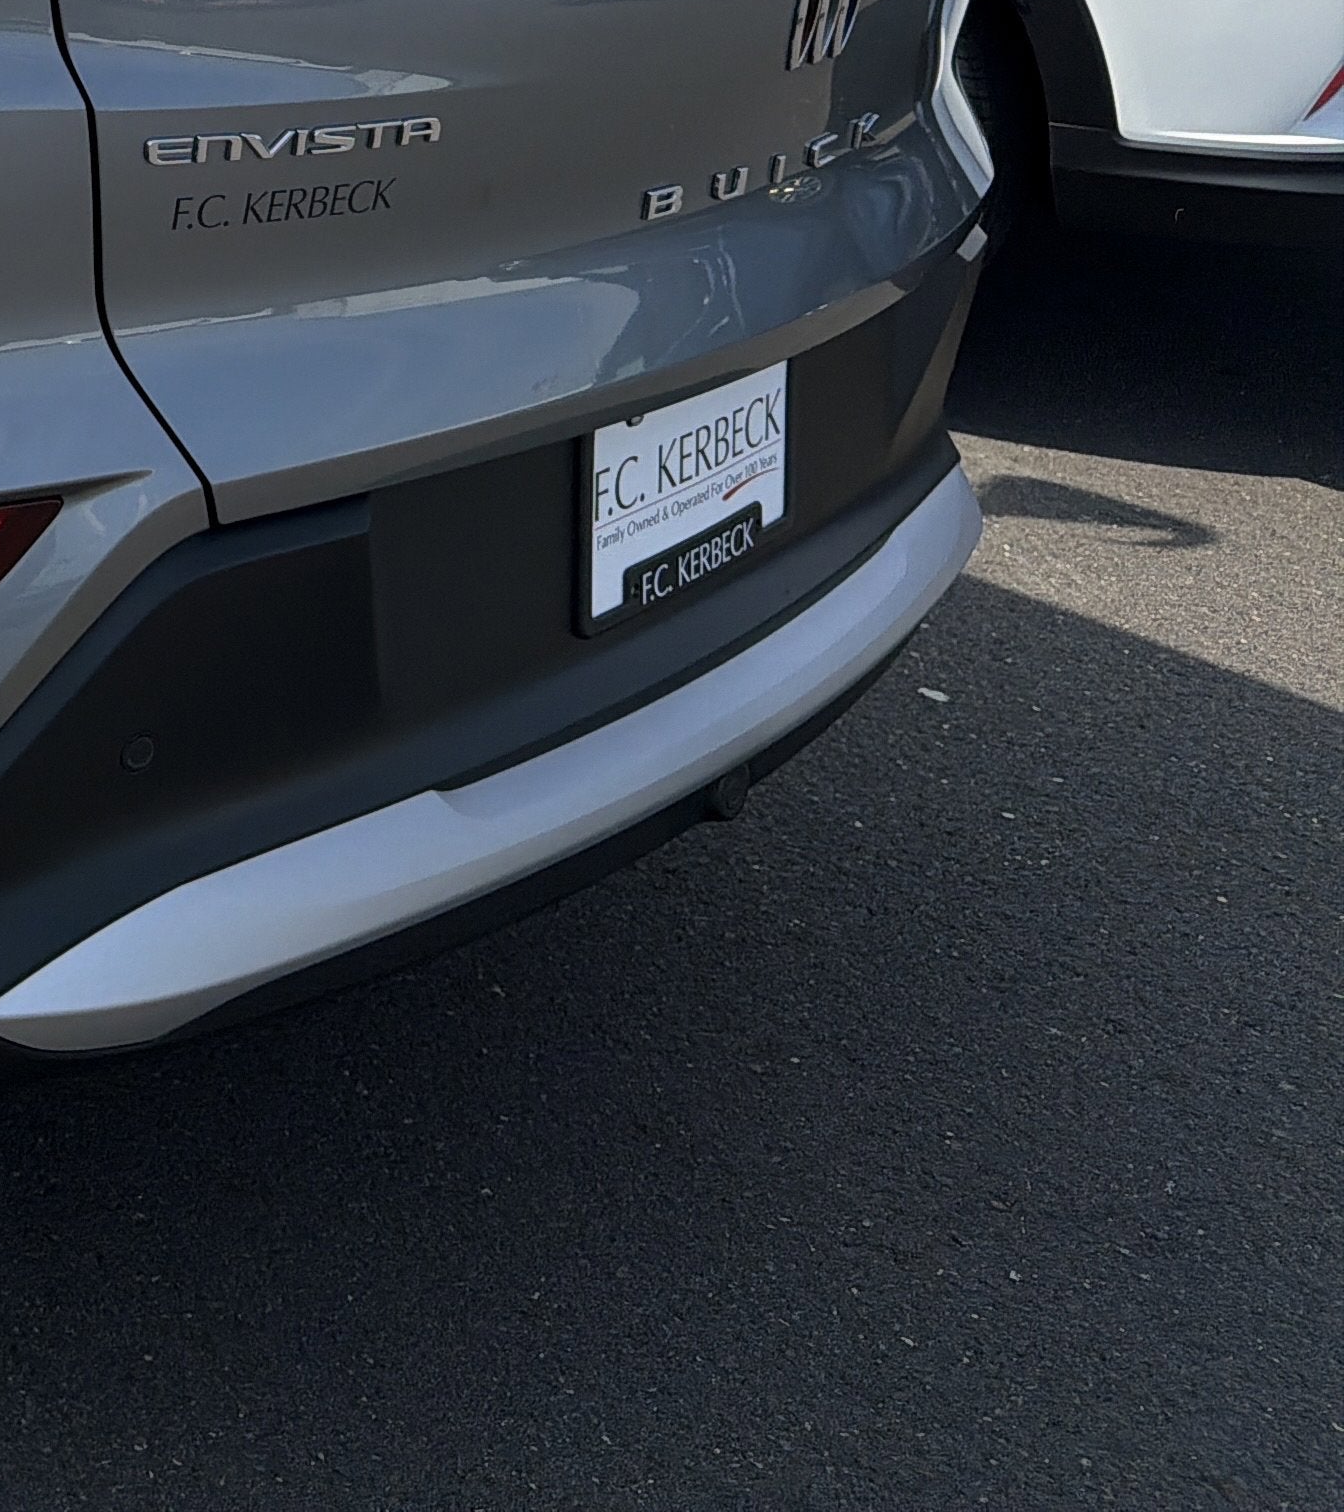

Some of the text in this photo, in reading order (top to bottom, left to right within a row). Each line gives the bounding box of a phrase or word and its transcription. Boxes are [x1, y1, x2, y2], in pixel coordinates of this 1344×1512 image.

[143, 115, 442, 167] ENVISTA
[639, 111, 882, 222] BUICK
[171, 176, 397, 231] F.C. KERBECK
[594, 387, 782, 522] F.C. KERBECK
[596, 452, 778, 552] Family Owned & Operated For Over 100 Years
[642, 517, 754, 606] F.C. KERBECK
